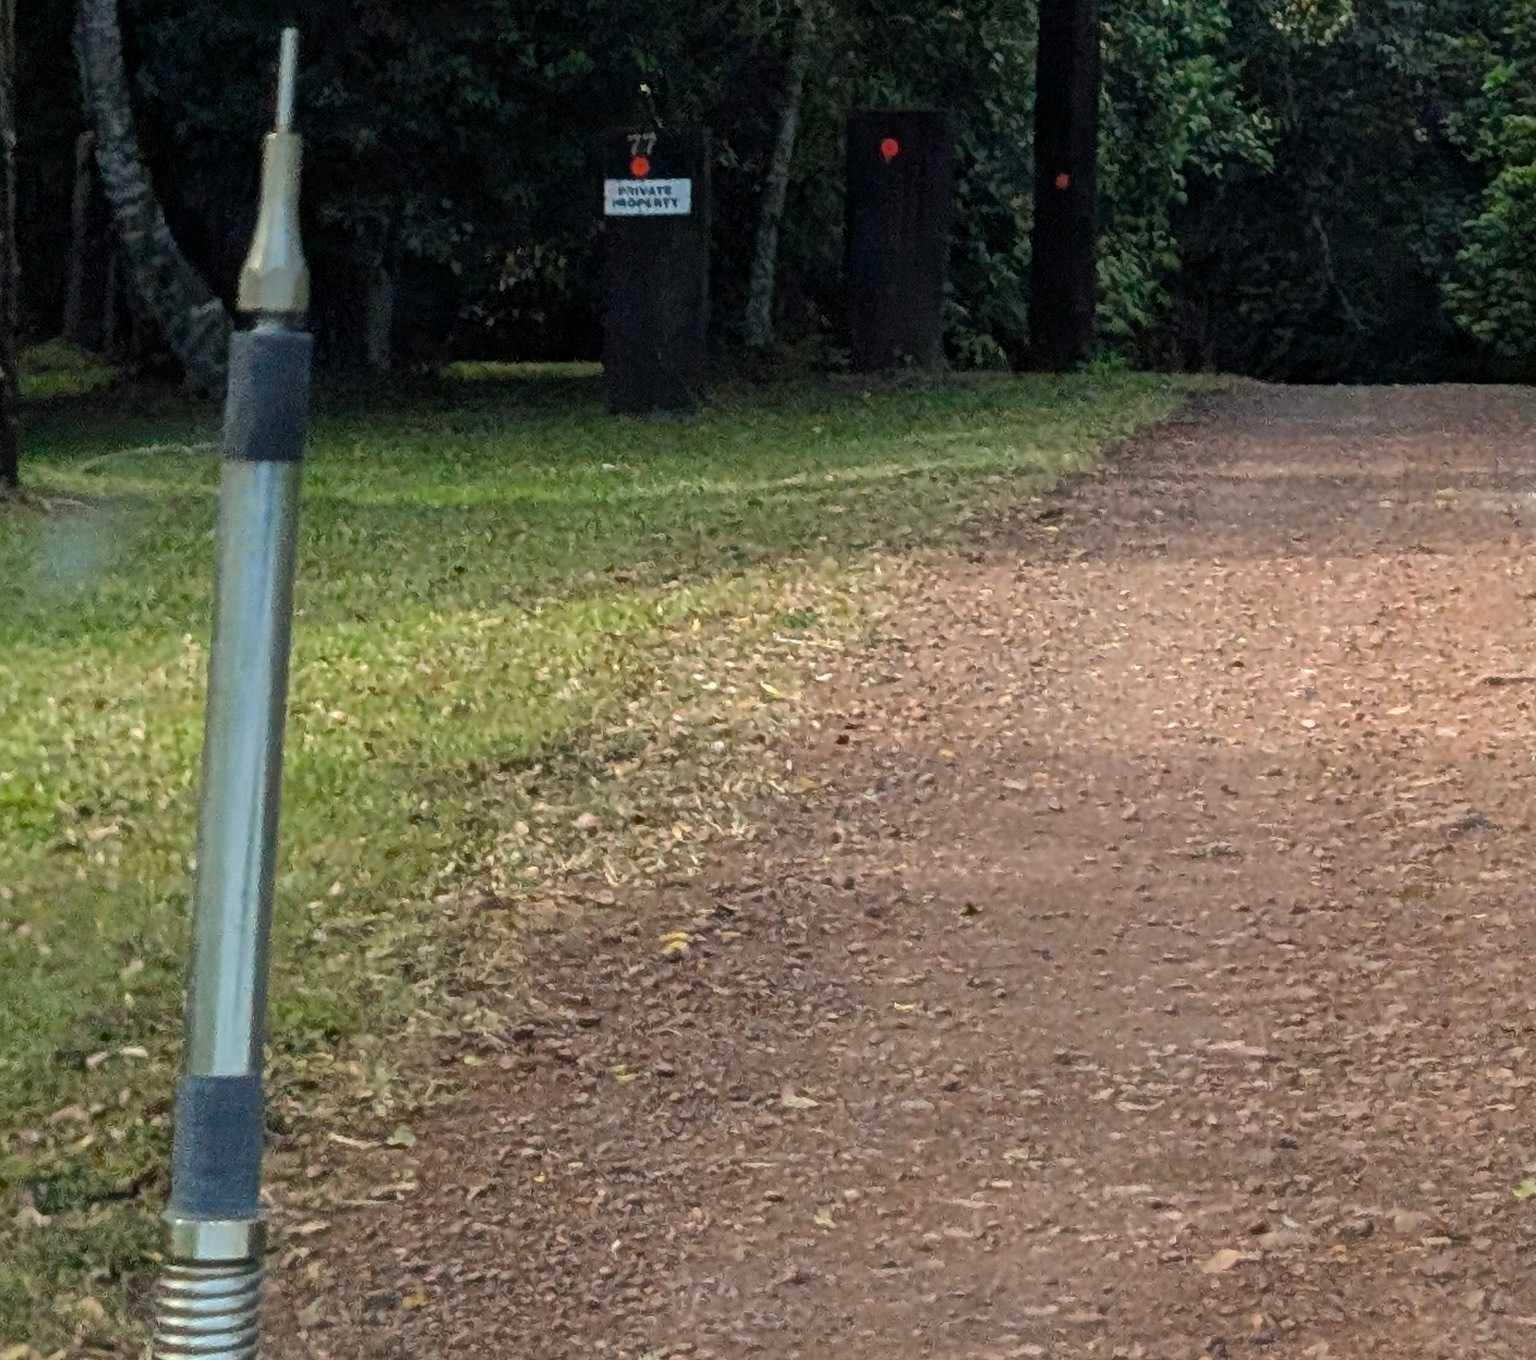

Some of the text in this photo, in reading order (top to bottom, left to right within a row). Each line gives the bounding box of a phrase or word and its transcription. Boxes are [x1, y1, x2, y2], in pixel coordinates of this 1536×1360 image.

[627, 131, 657, 156] 77
[617, 185, 672, 196] PRIVATE
[612, 197, 678, 209] PROPERTY
